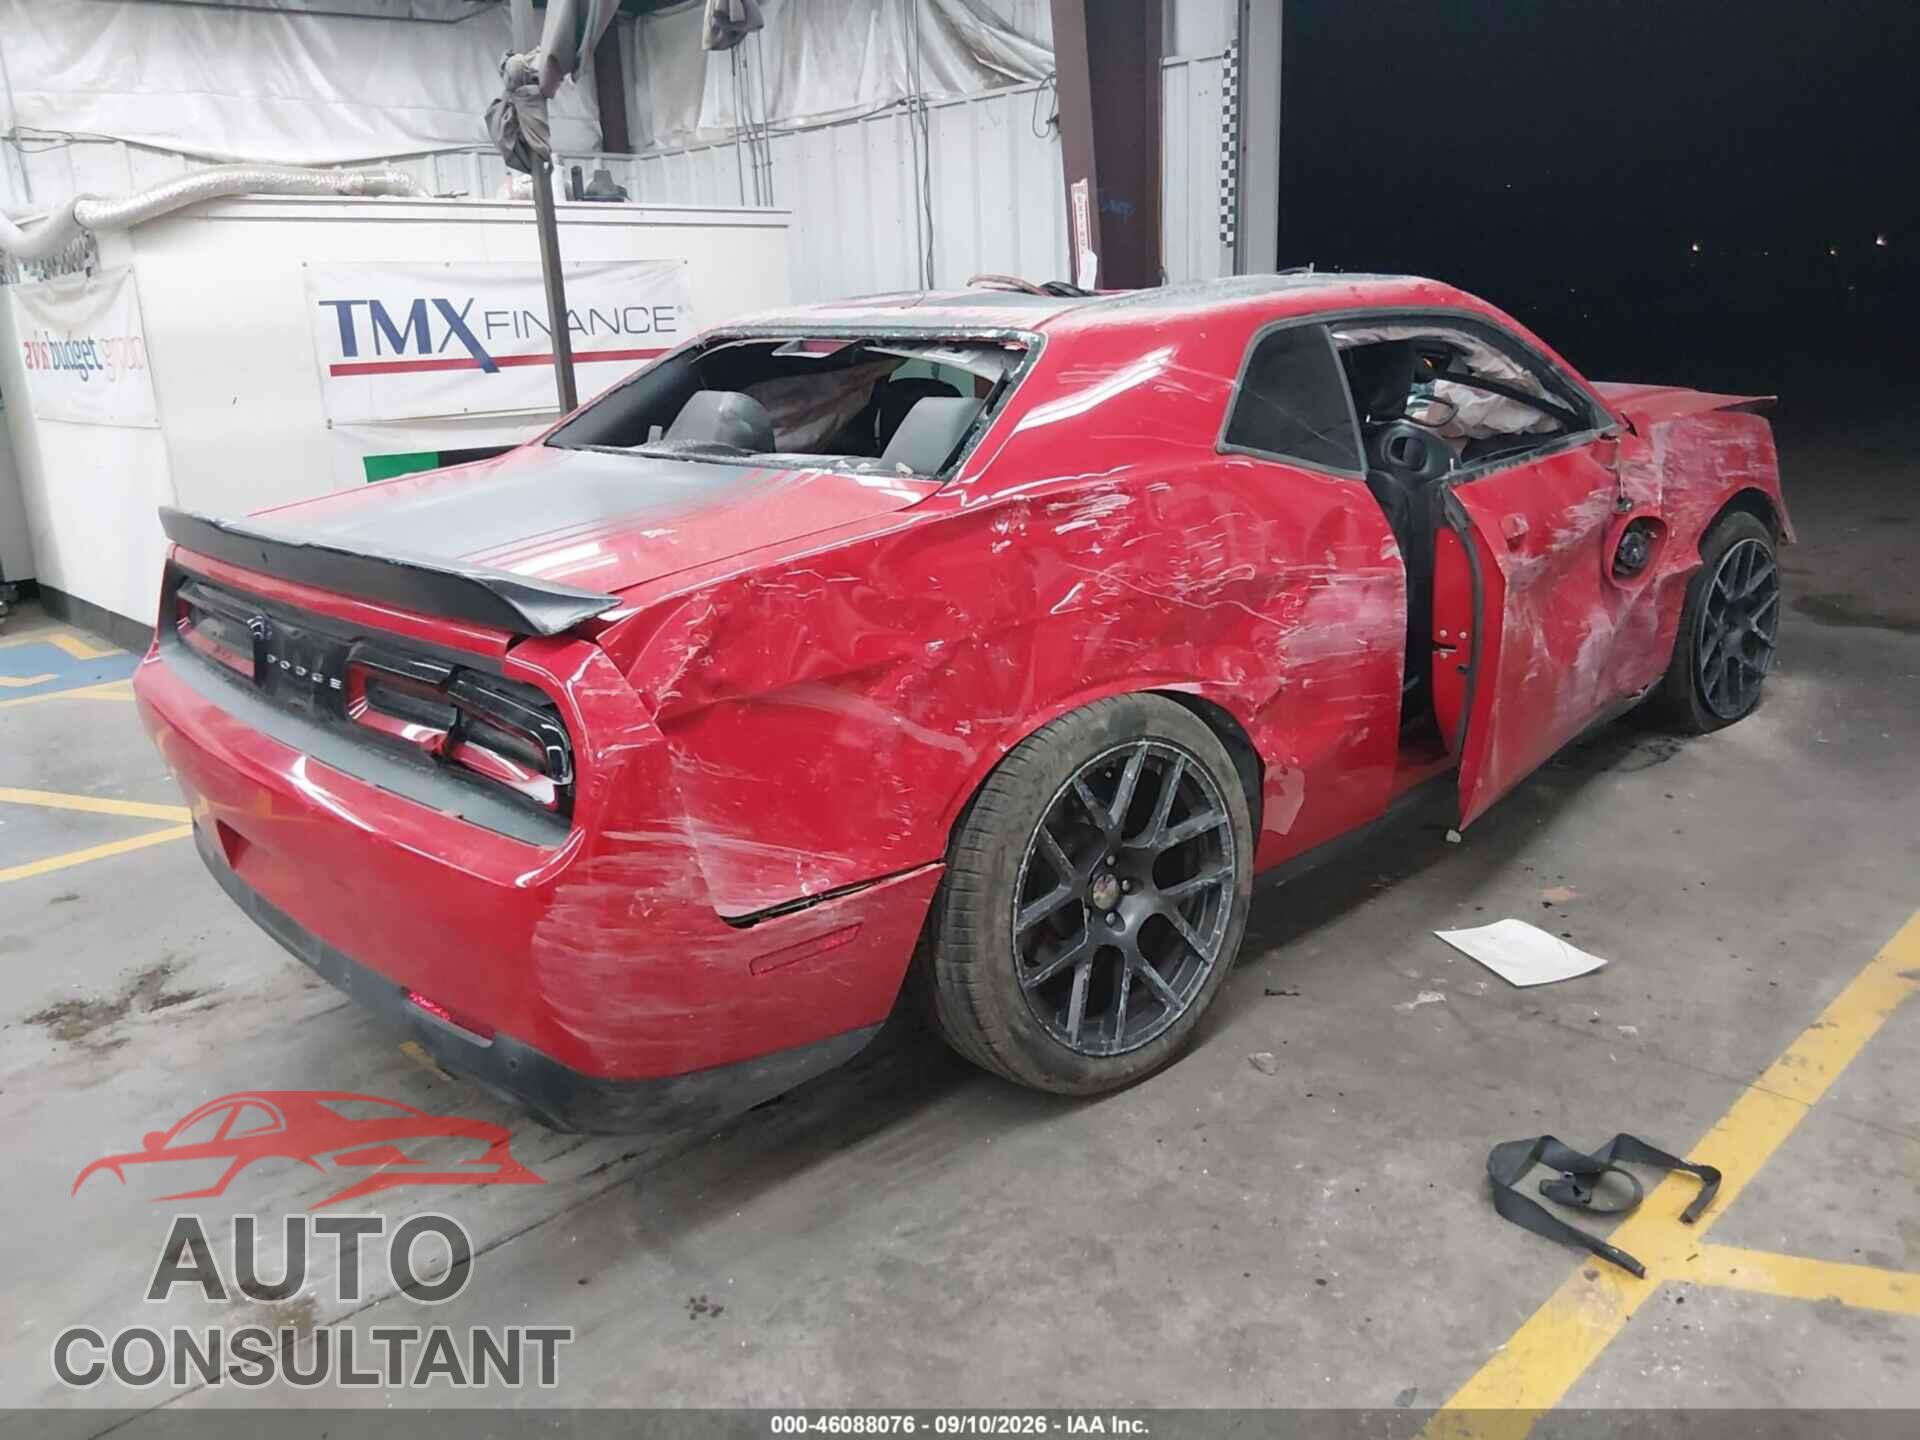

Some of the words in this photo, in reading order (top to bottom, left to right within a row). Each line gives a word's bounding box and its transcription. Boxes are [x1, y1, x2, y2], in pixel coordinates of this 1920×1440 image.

[24, 330, 50, 369] avis
[46, 330, 103, 382] budget
[318, 297, 500, 374] TMX
[484, 306, 677, 340] FINANCE
[266, 653, 342, 690] DODGE
